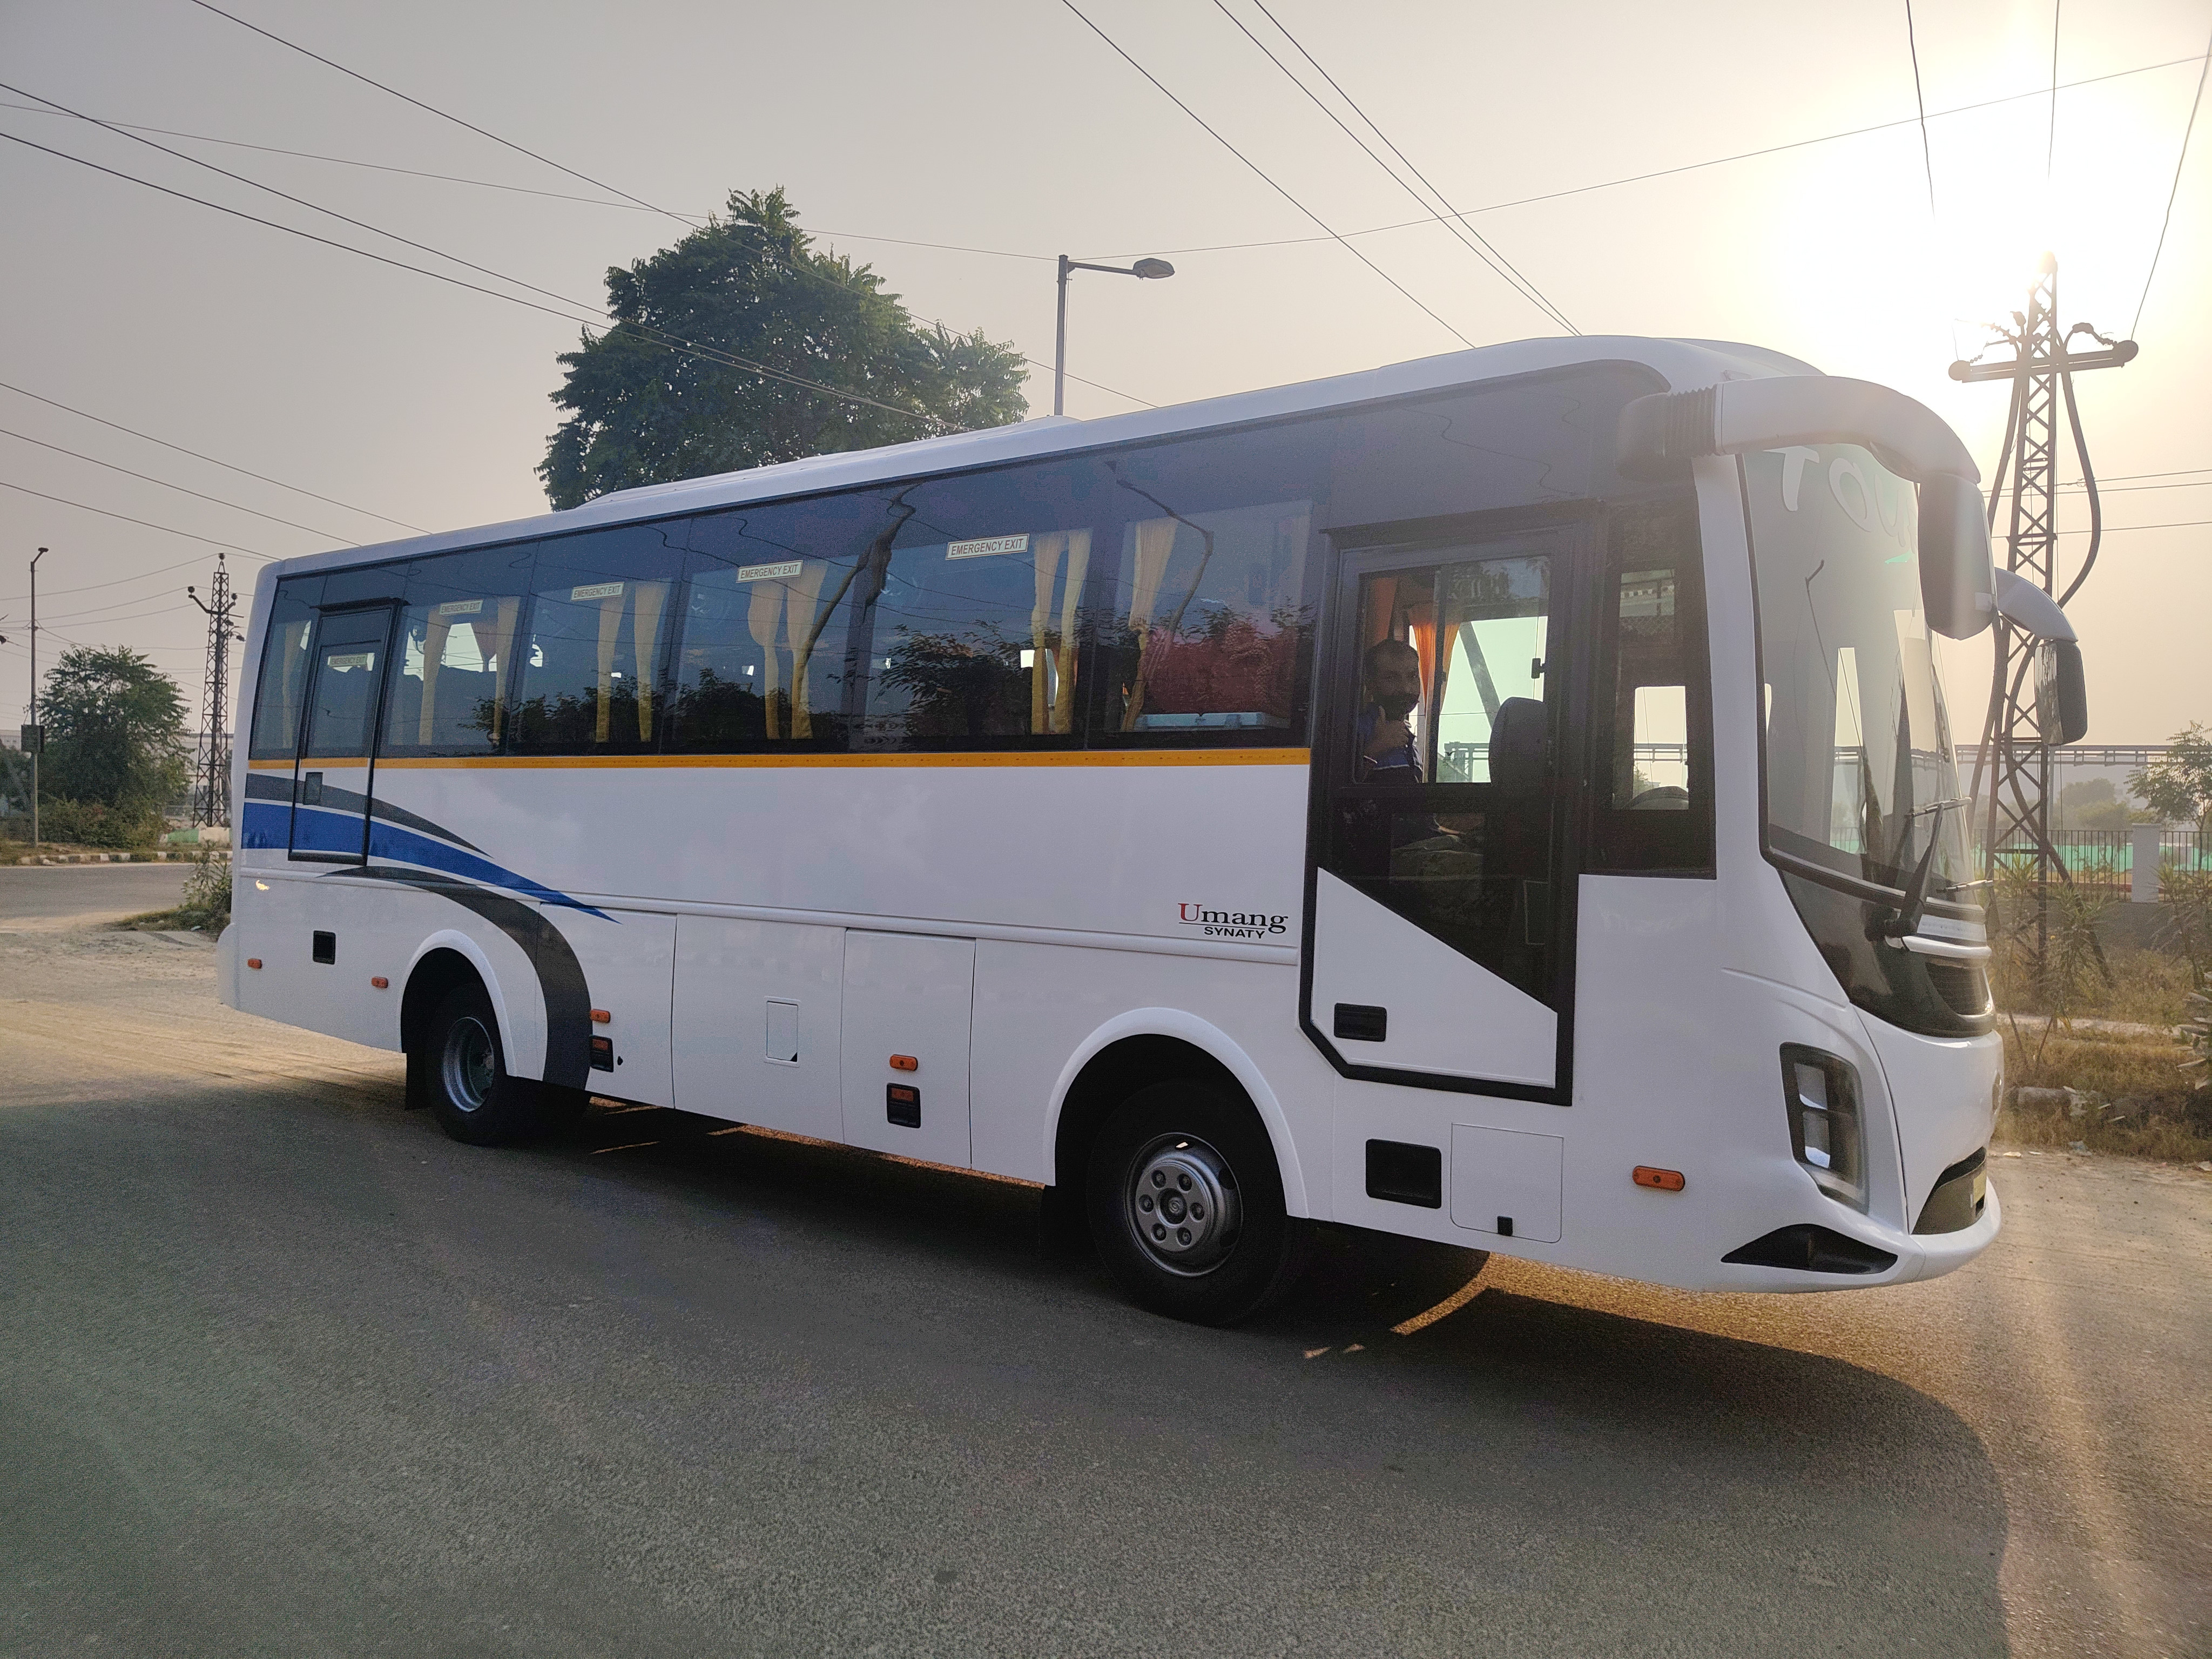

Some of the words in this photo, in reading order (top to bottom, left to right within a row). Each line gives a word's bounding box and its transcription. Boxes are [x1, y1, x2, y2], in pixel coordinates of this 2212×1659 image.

[951, 541, 1003, 555] EMERGENCY
[1004, 538, 1023, 550] EXIT
[740, 566, 782, 579] EMERGENCY
[783, 564, 798, 574] EXIT
[574, 587, 608, 598] EMERGENCY
[608, 585, 621, 594] EXIT
[1178, 903, 1289, 934] Umang
[1204, 926, 1265, 939] SYNATY
